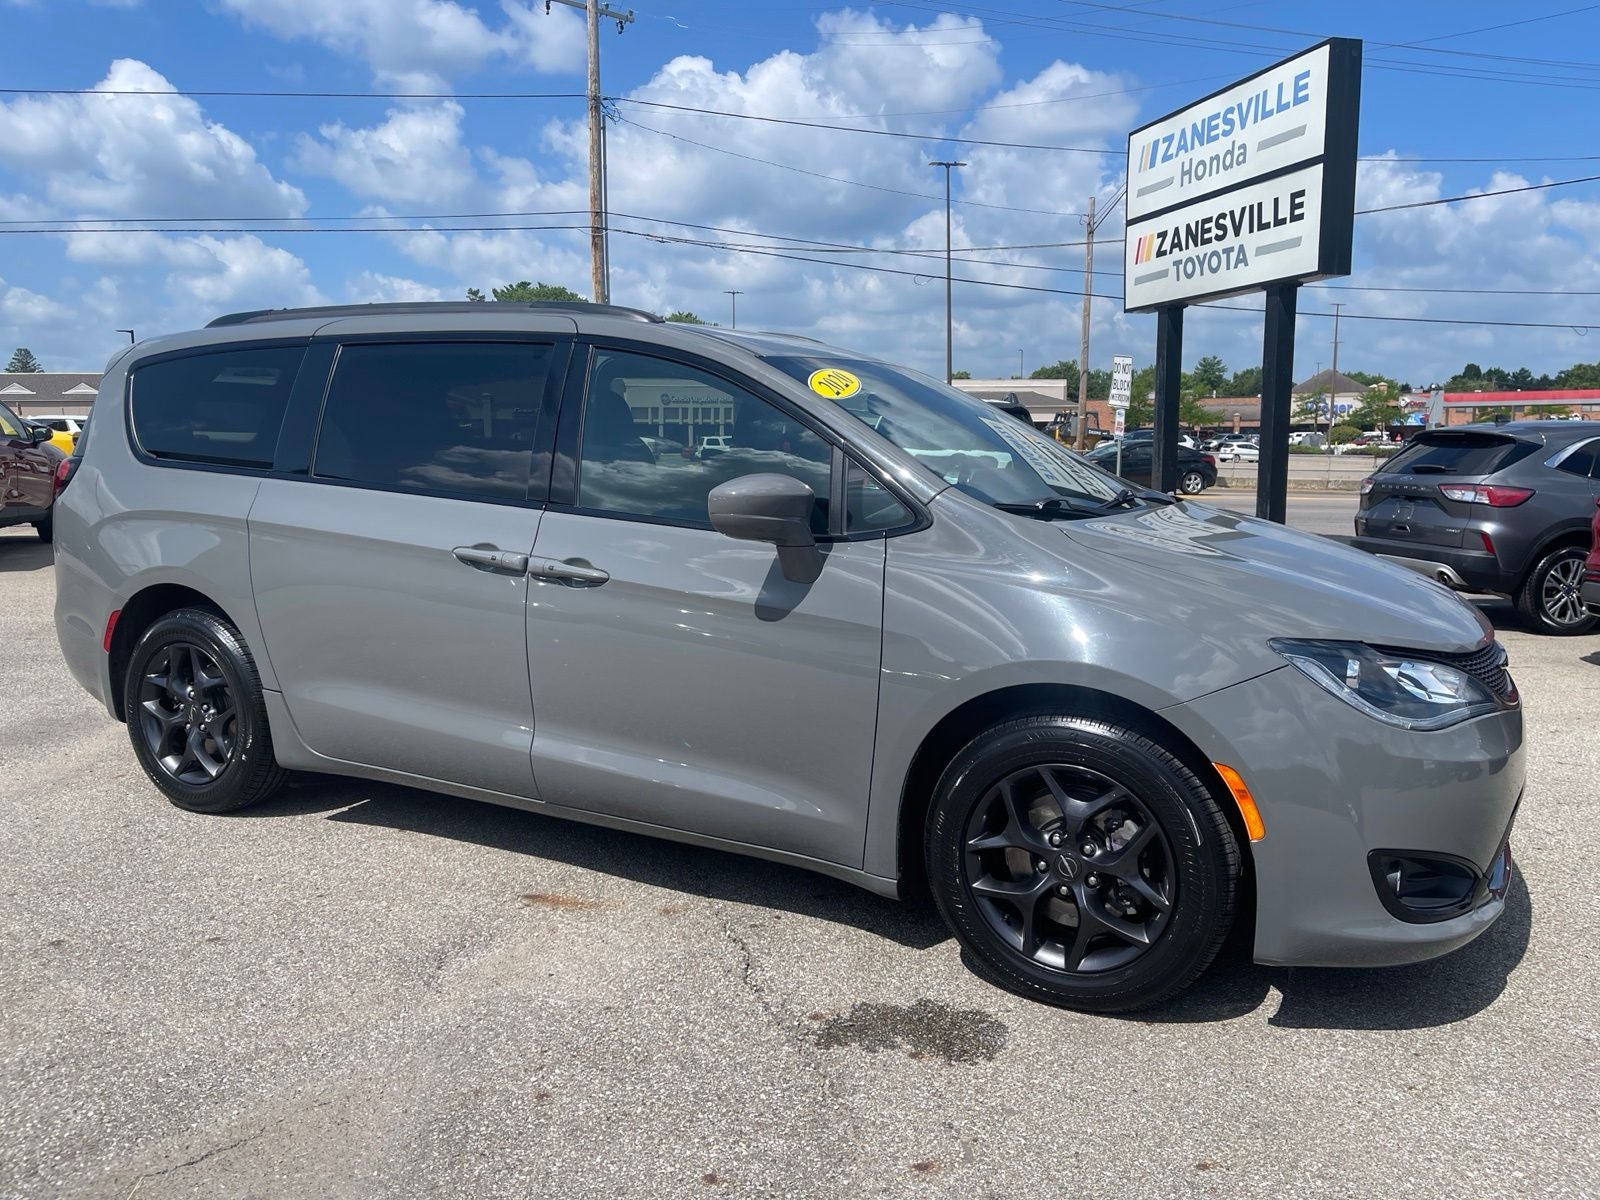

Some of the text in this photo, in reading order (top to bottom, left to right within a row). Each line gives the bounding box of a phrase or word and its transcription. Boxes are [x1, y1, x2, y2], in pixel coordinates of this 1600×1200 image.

[1160, 69, 1311, 164] ZANESVILLE
[1179, 140, 1247, 188] Honda
[1155, 188, 1306, 258] ZANESVILLE
[1172, 243, 1249, 282] TOYOTA
[1112, 378, 1130, 391] BLOCK
[1113, 362, 1131, 375] DO NOT
[1305, 399, 1353, 421] oger
